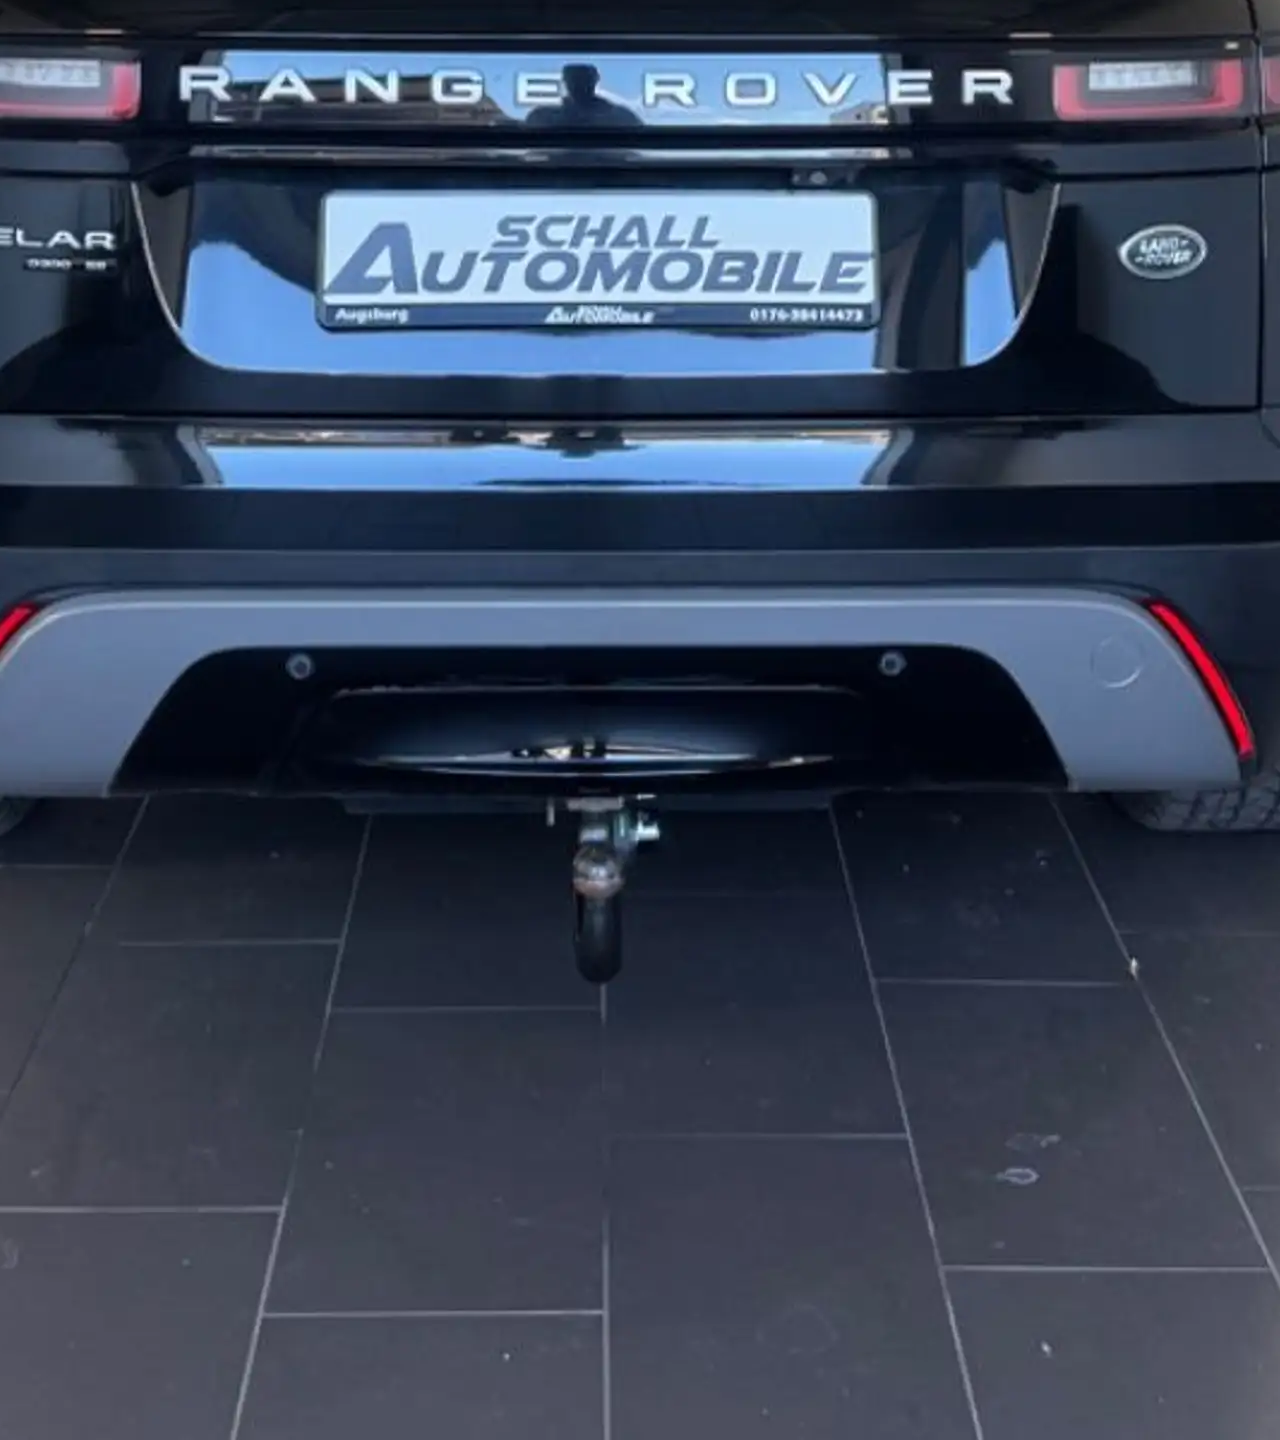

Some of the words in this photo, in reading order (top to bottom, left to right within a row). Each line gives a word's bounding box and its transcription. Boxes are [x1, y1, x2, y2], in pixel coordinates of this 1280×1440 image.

[179, 65, 562, 105] RANGE
[642, 67, 1014, 105] ROVER
[490, 215, 720, 248] SCHALL
[323, 221, 875, 295] AUTOMOBILE
[334, 307, 409, 325] Augsburg
